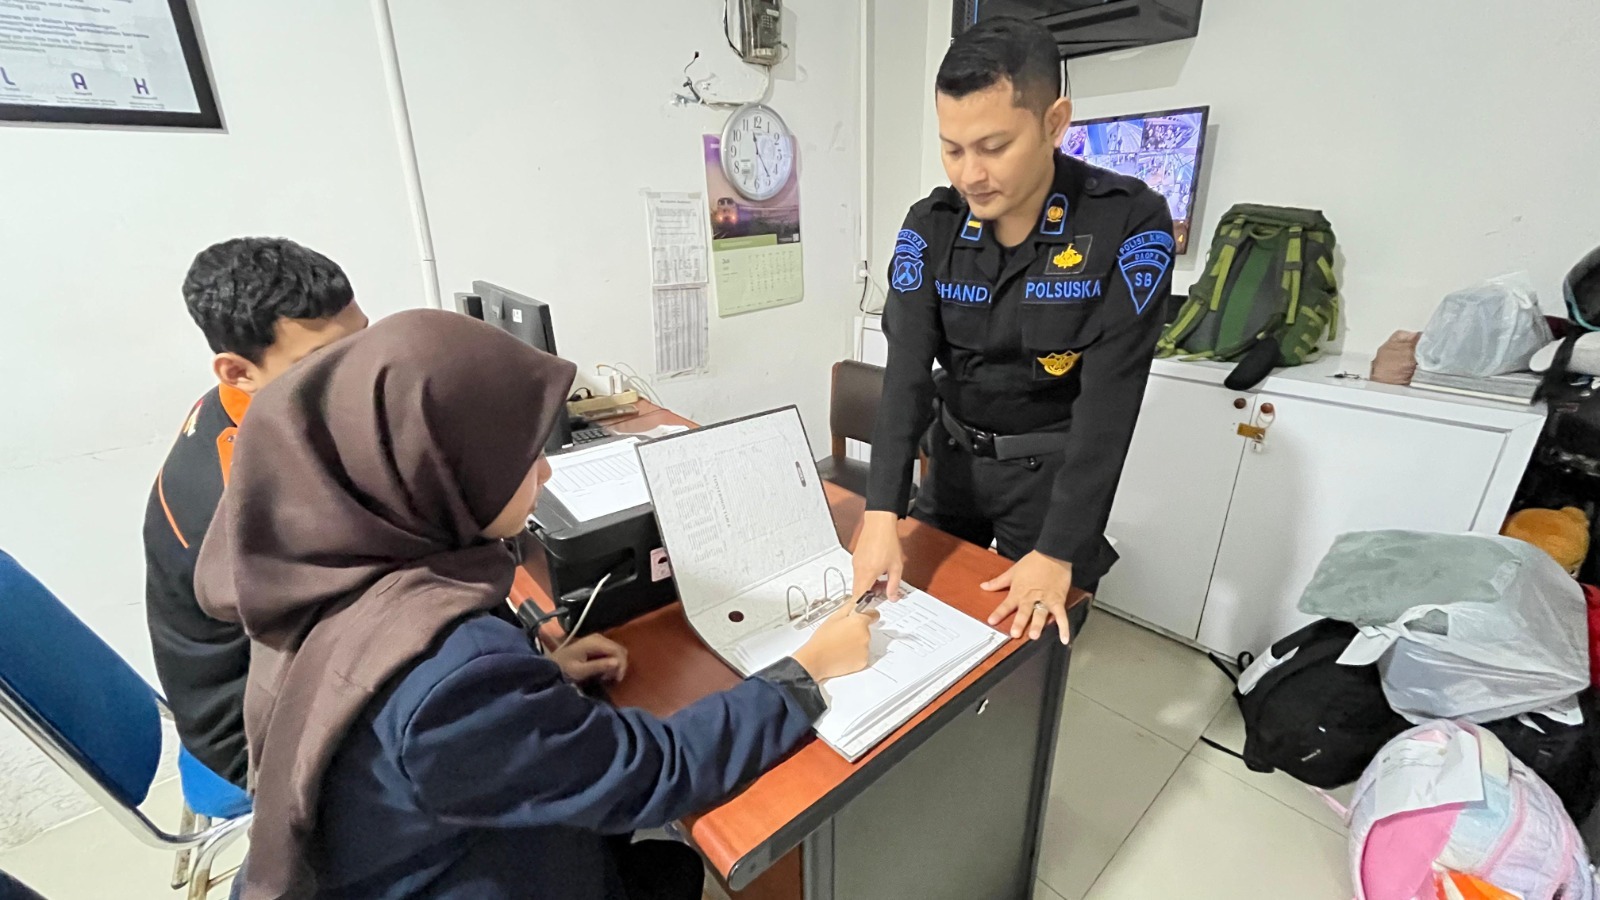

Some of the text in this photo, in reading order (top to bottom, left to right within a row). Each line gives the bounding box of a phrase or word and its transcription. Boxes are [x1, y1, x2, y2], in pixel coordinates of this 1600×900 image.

[71, 72, 88, 90] A
[743, 119, 749, 132] 11
[753, 115, 762, 129] 12
[733, 129, 742, 142] 10
[774, 133, 780, 145] 2
[731, 145, 737, 158] 9
[734, 161, 740, 174] 8
[772, 164, 778, 175] 4
[754, 178, 760, 189] 6
[899, 231, 923, 247] POLDA
[1119, 236, 1145, 255] POLISI
[1135, 272, 1152, 287] SB
[1025, 279, 1101, 299] POLSUSKA
